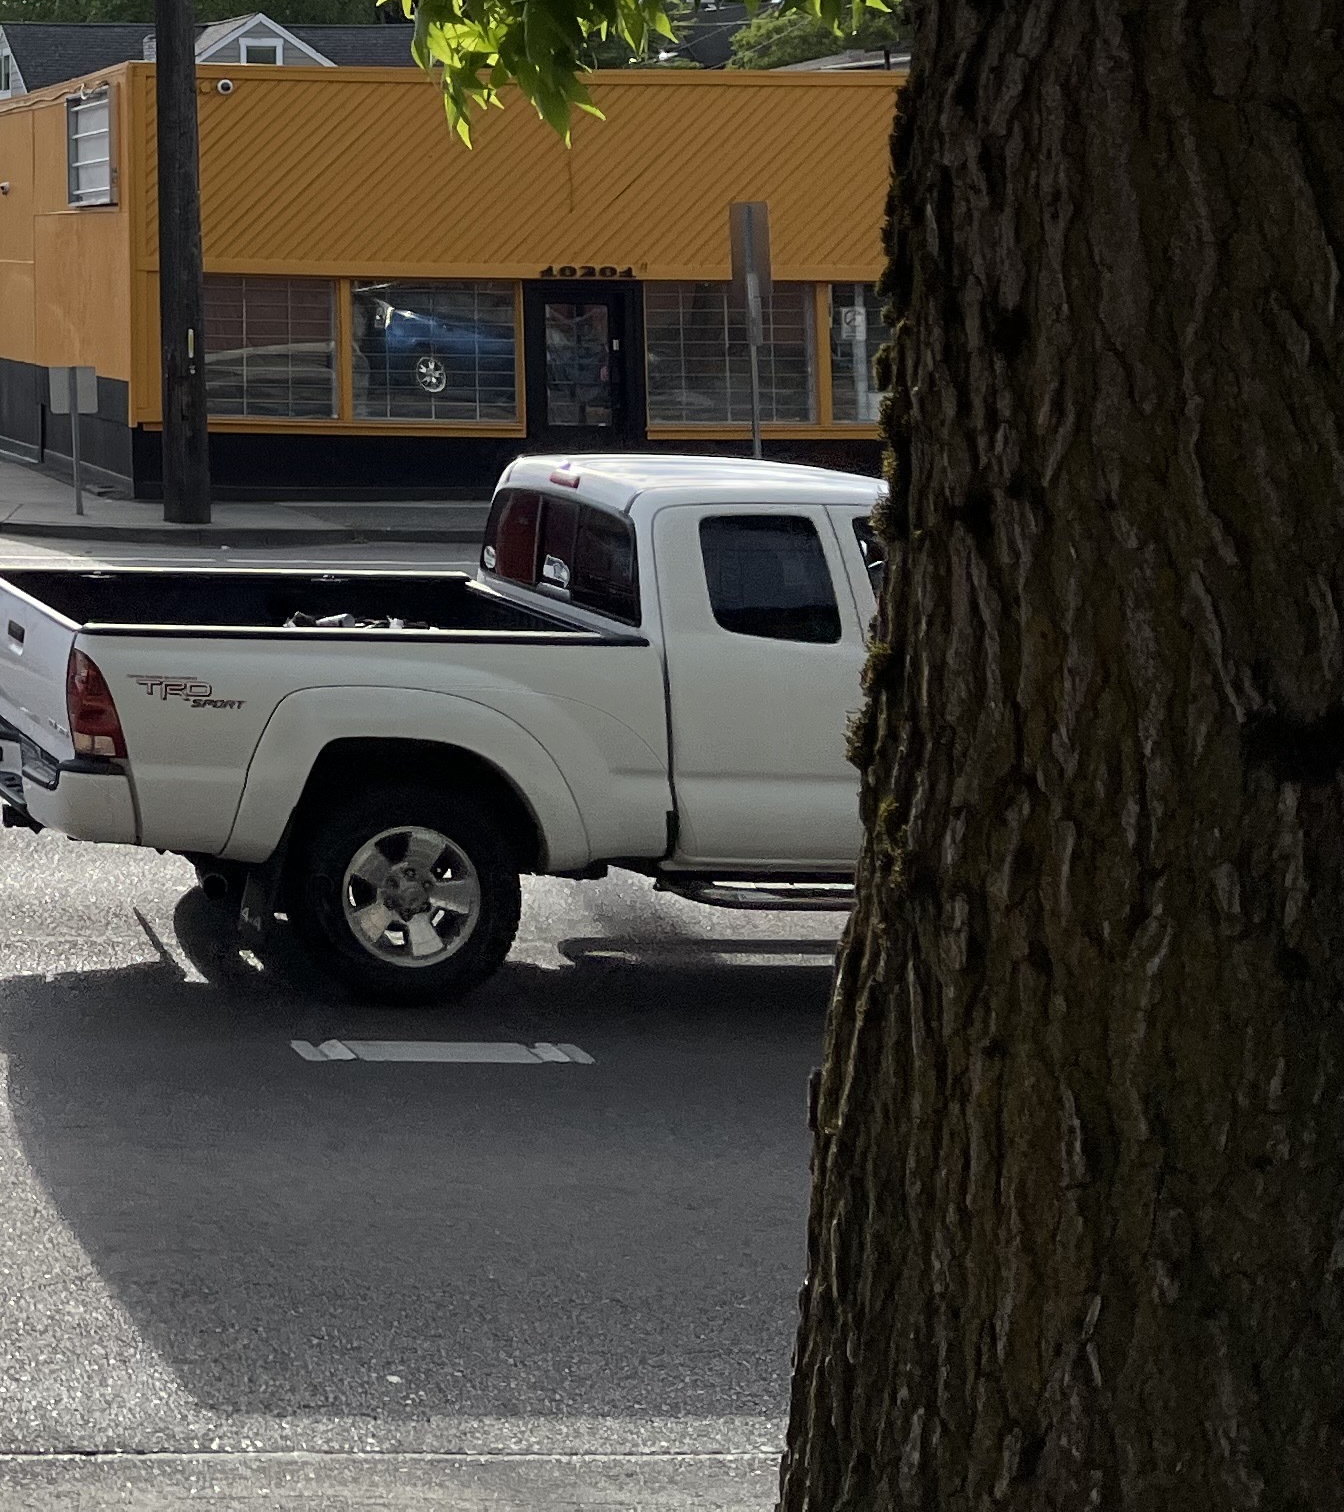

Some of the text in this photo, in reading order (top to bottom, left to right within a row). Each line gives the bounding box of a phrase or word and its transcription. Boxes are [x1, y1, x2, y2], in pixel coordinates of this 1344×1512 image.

[539, 265, 637, 278] 10201
[136, 679, 213, 701] TRD
[191, 698, 247, 710] SPORT
